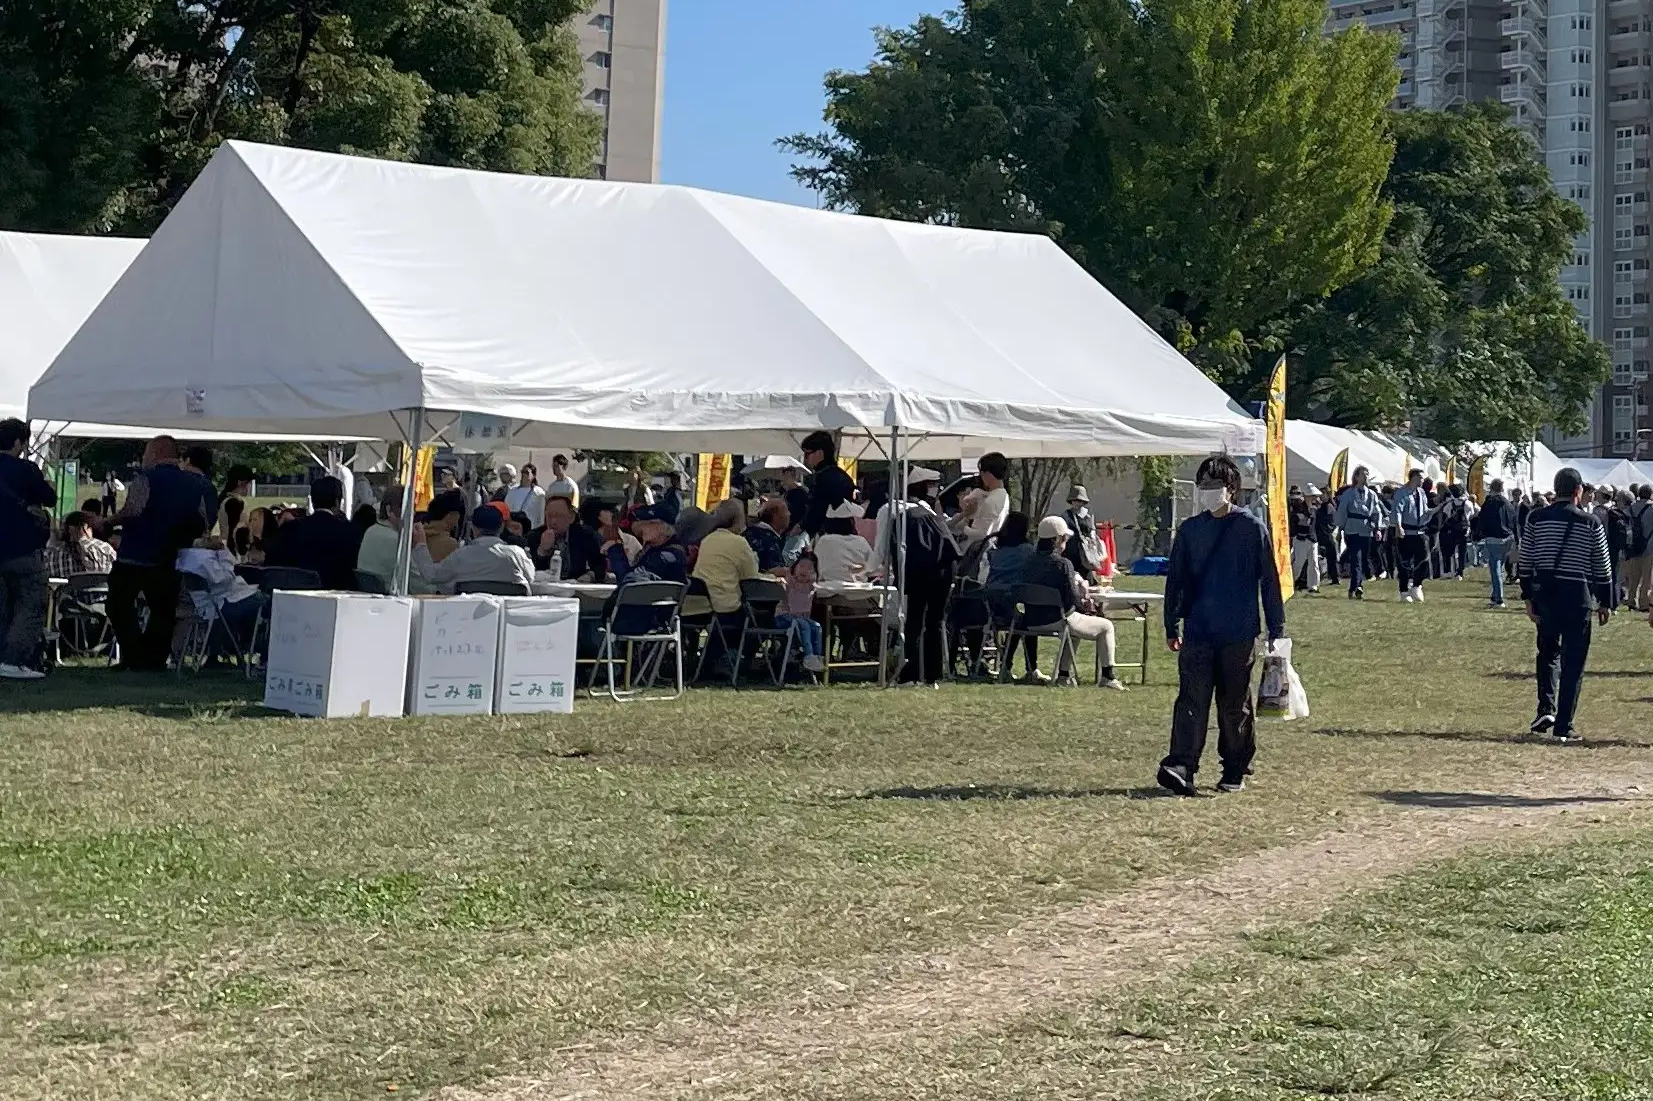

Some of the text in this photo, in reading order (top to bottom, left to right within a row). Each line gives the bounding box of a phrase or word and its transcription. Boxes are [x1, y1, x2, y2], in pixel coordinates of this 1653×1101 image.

[424, 683, 482, 700] ごみ箱
[509, 681, 564, 697] ごみ箱
